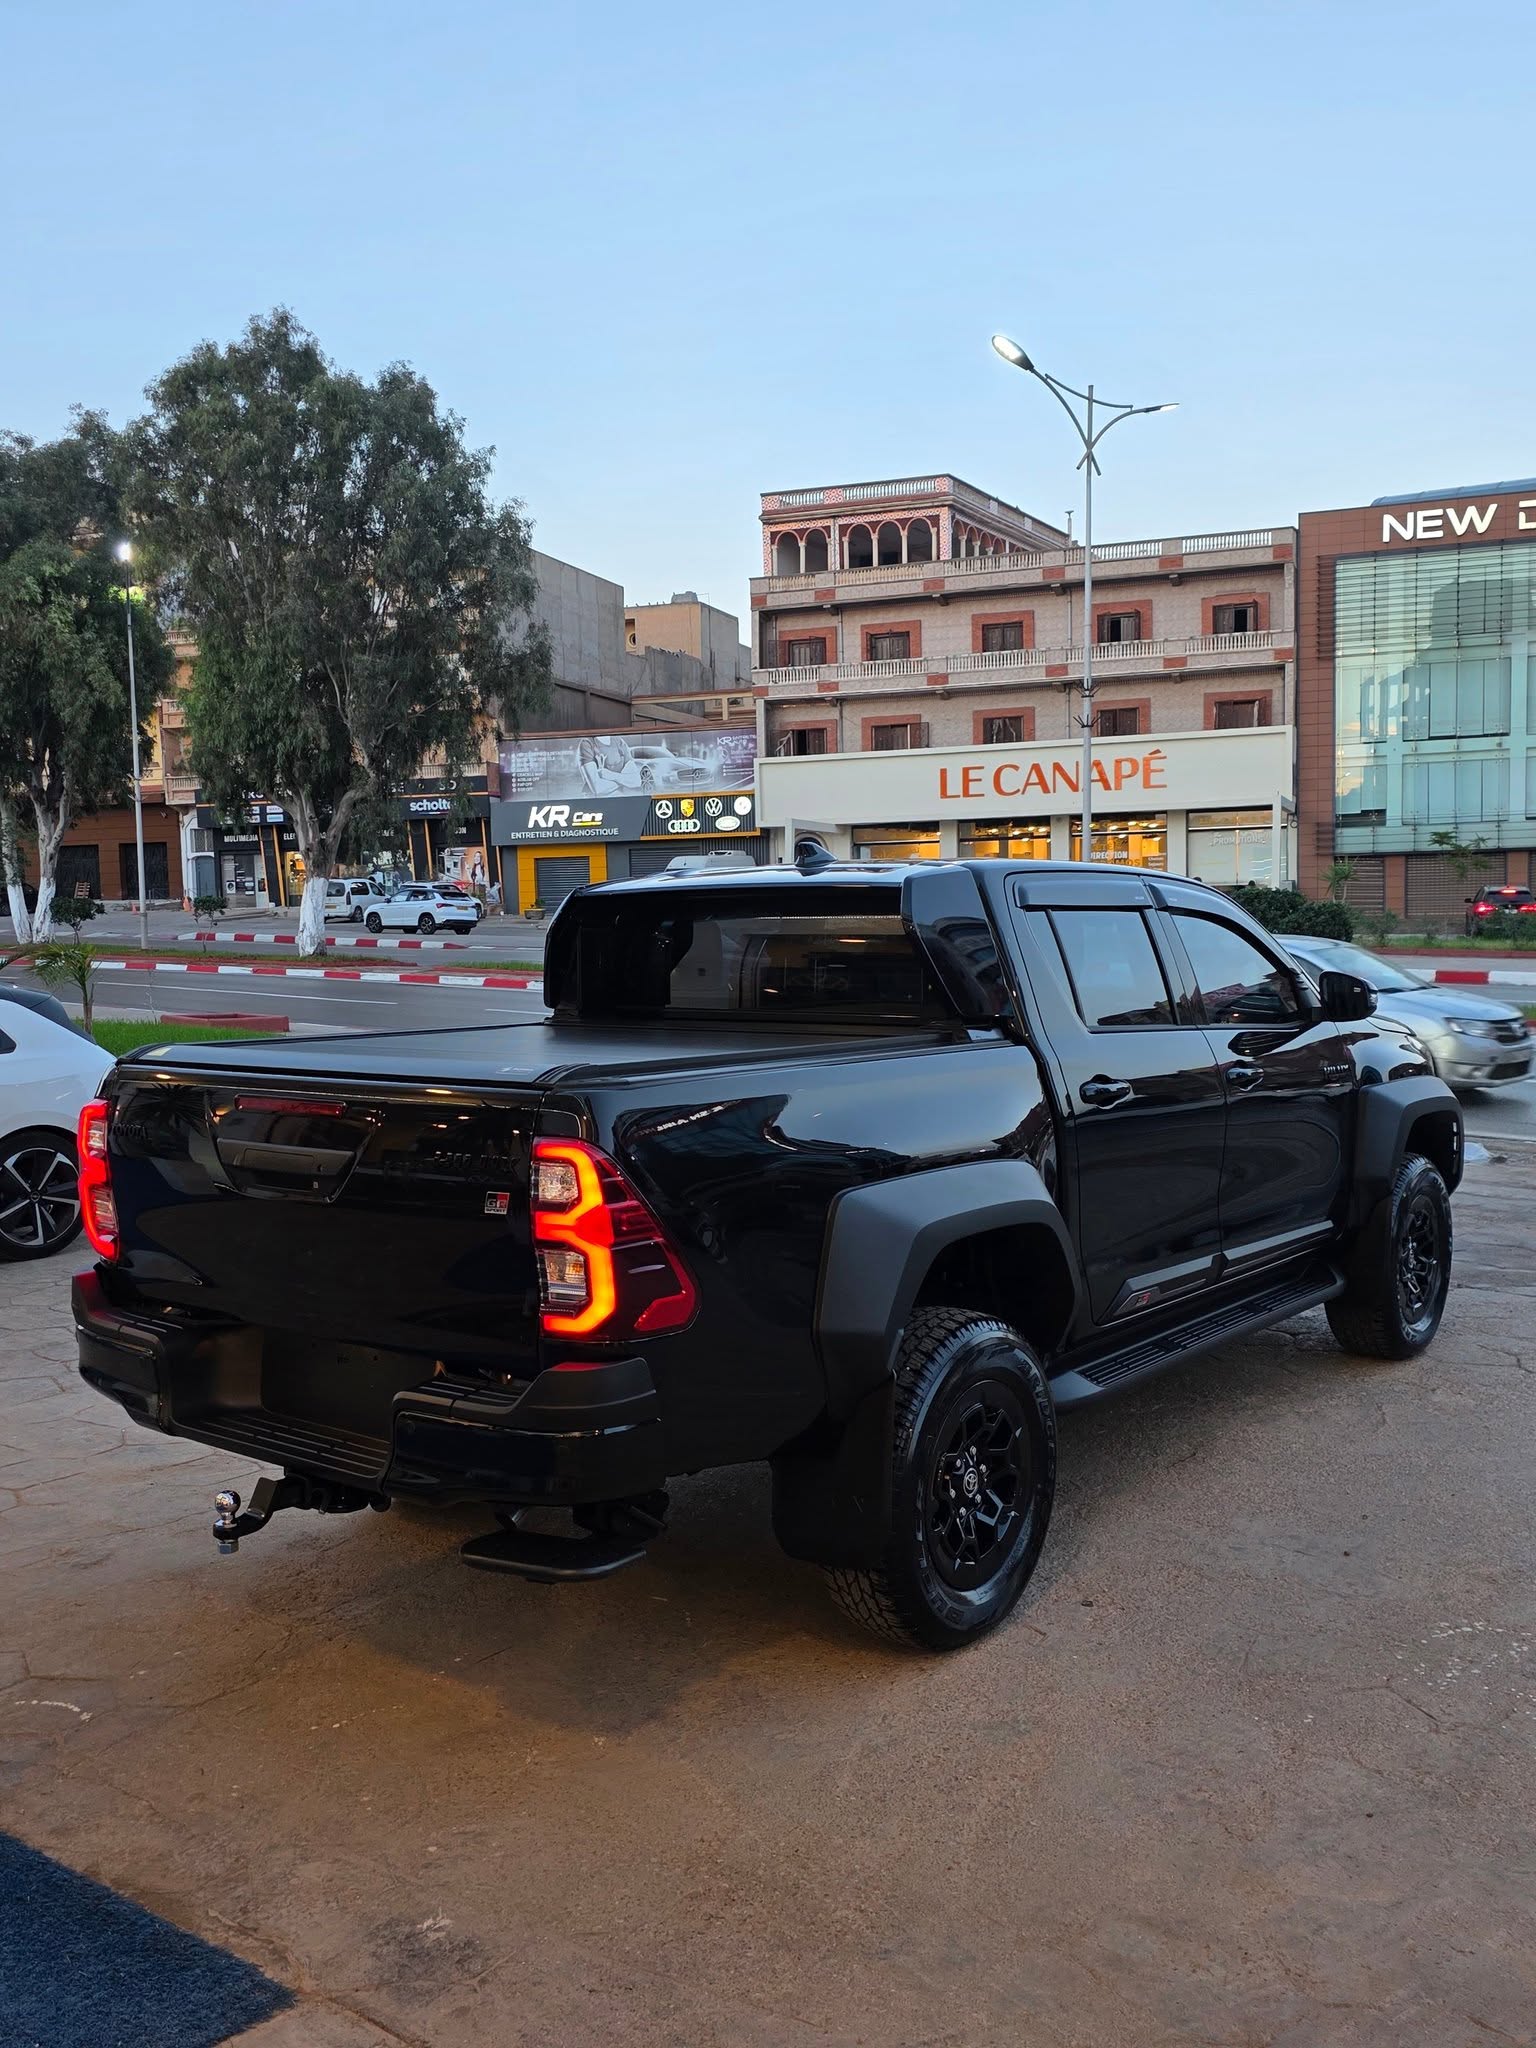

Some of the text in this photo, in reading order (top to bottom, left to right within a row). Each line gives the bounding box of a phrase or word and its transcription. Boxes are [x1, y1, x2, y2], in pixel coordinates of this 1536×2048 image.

[1382, 503, 1498, 543] NEW
[939, 748, 1168, 799] LE CANAPÉ
[409, 799, 452, 812] scholt
[528, 804, 570, 828] KR
[511, 831, 553, 839] ENTRETIEN
[560, 828, 619, 837] DIAGNOSTIQUE
[1213, 835, 1264, 845] PROMTIONS
[1091, 851, 1128, 859] IRECION
[487, 1198, 507, 1208] GR
